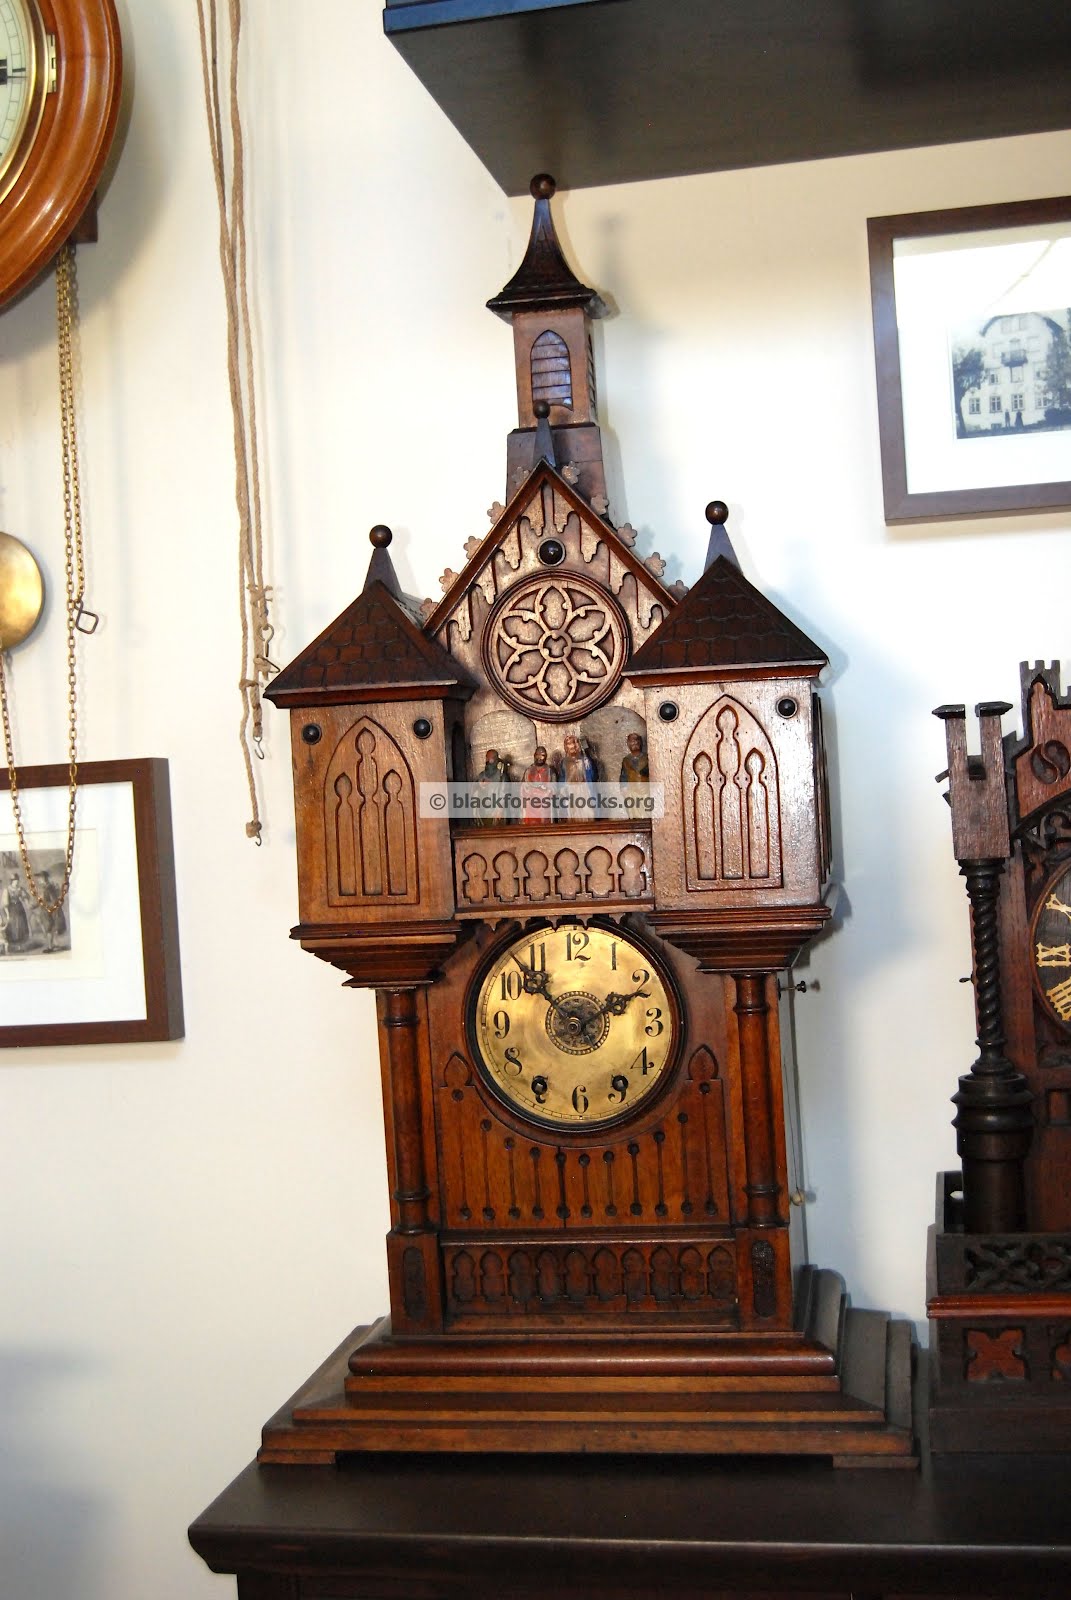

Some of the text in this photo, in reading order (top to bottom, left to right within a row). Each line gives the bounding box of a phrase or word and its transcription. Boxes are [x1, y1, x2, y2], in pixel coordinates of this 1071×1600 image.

[529, 942, 545, 973] 11
[565, 932, 591, 961] 12
[610, 942, 618, 970] 1
[500, 970, 522, 1000] 10
[632, 969, 651, 998] 2
[494, 1011, 510, 1039] 9
[645, 1008, 663, 1037] 3
[504, 1047, 522, 1076] 8
[630, 1046, 654, 1075] 4
[572, 1085, 589, 1113] 6
